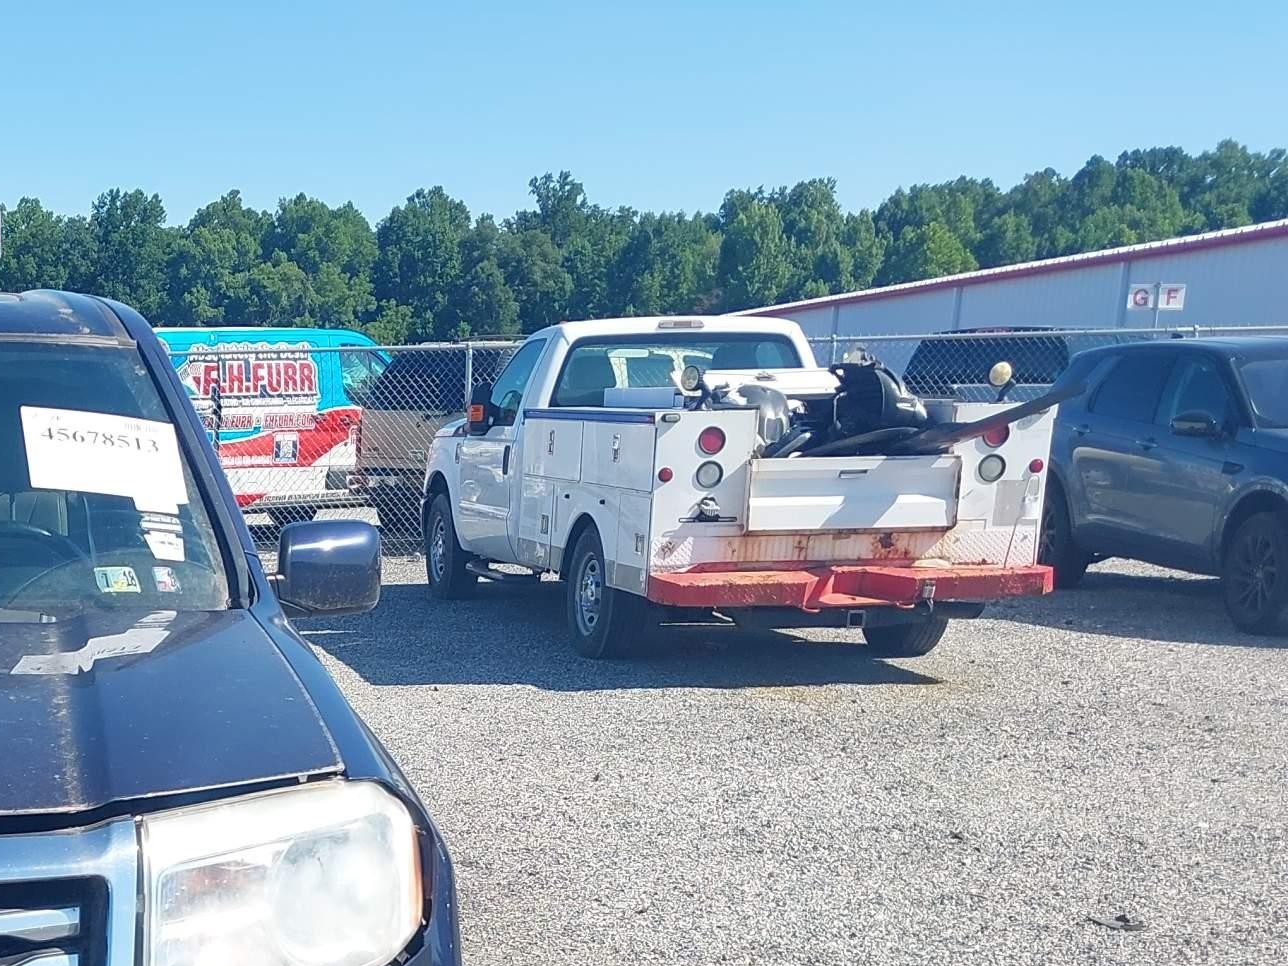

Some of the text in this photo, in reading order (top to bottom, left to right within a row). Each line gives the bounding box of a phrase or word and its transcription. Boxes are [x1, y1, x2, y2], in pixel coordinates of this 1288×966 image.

[1133, 288, 1178, 306] G F
[40, 427, 160, 453] 45678513
